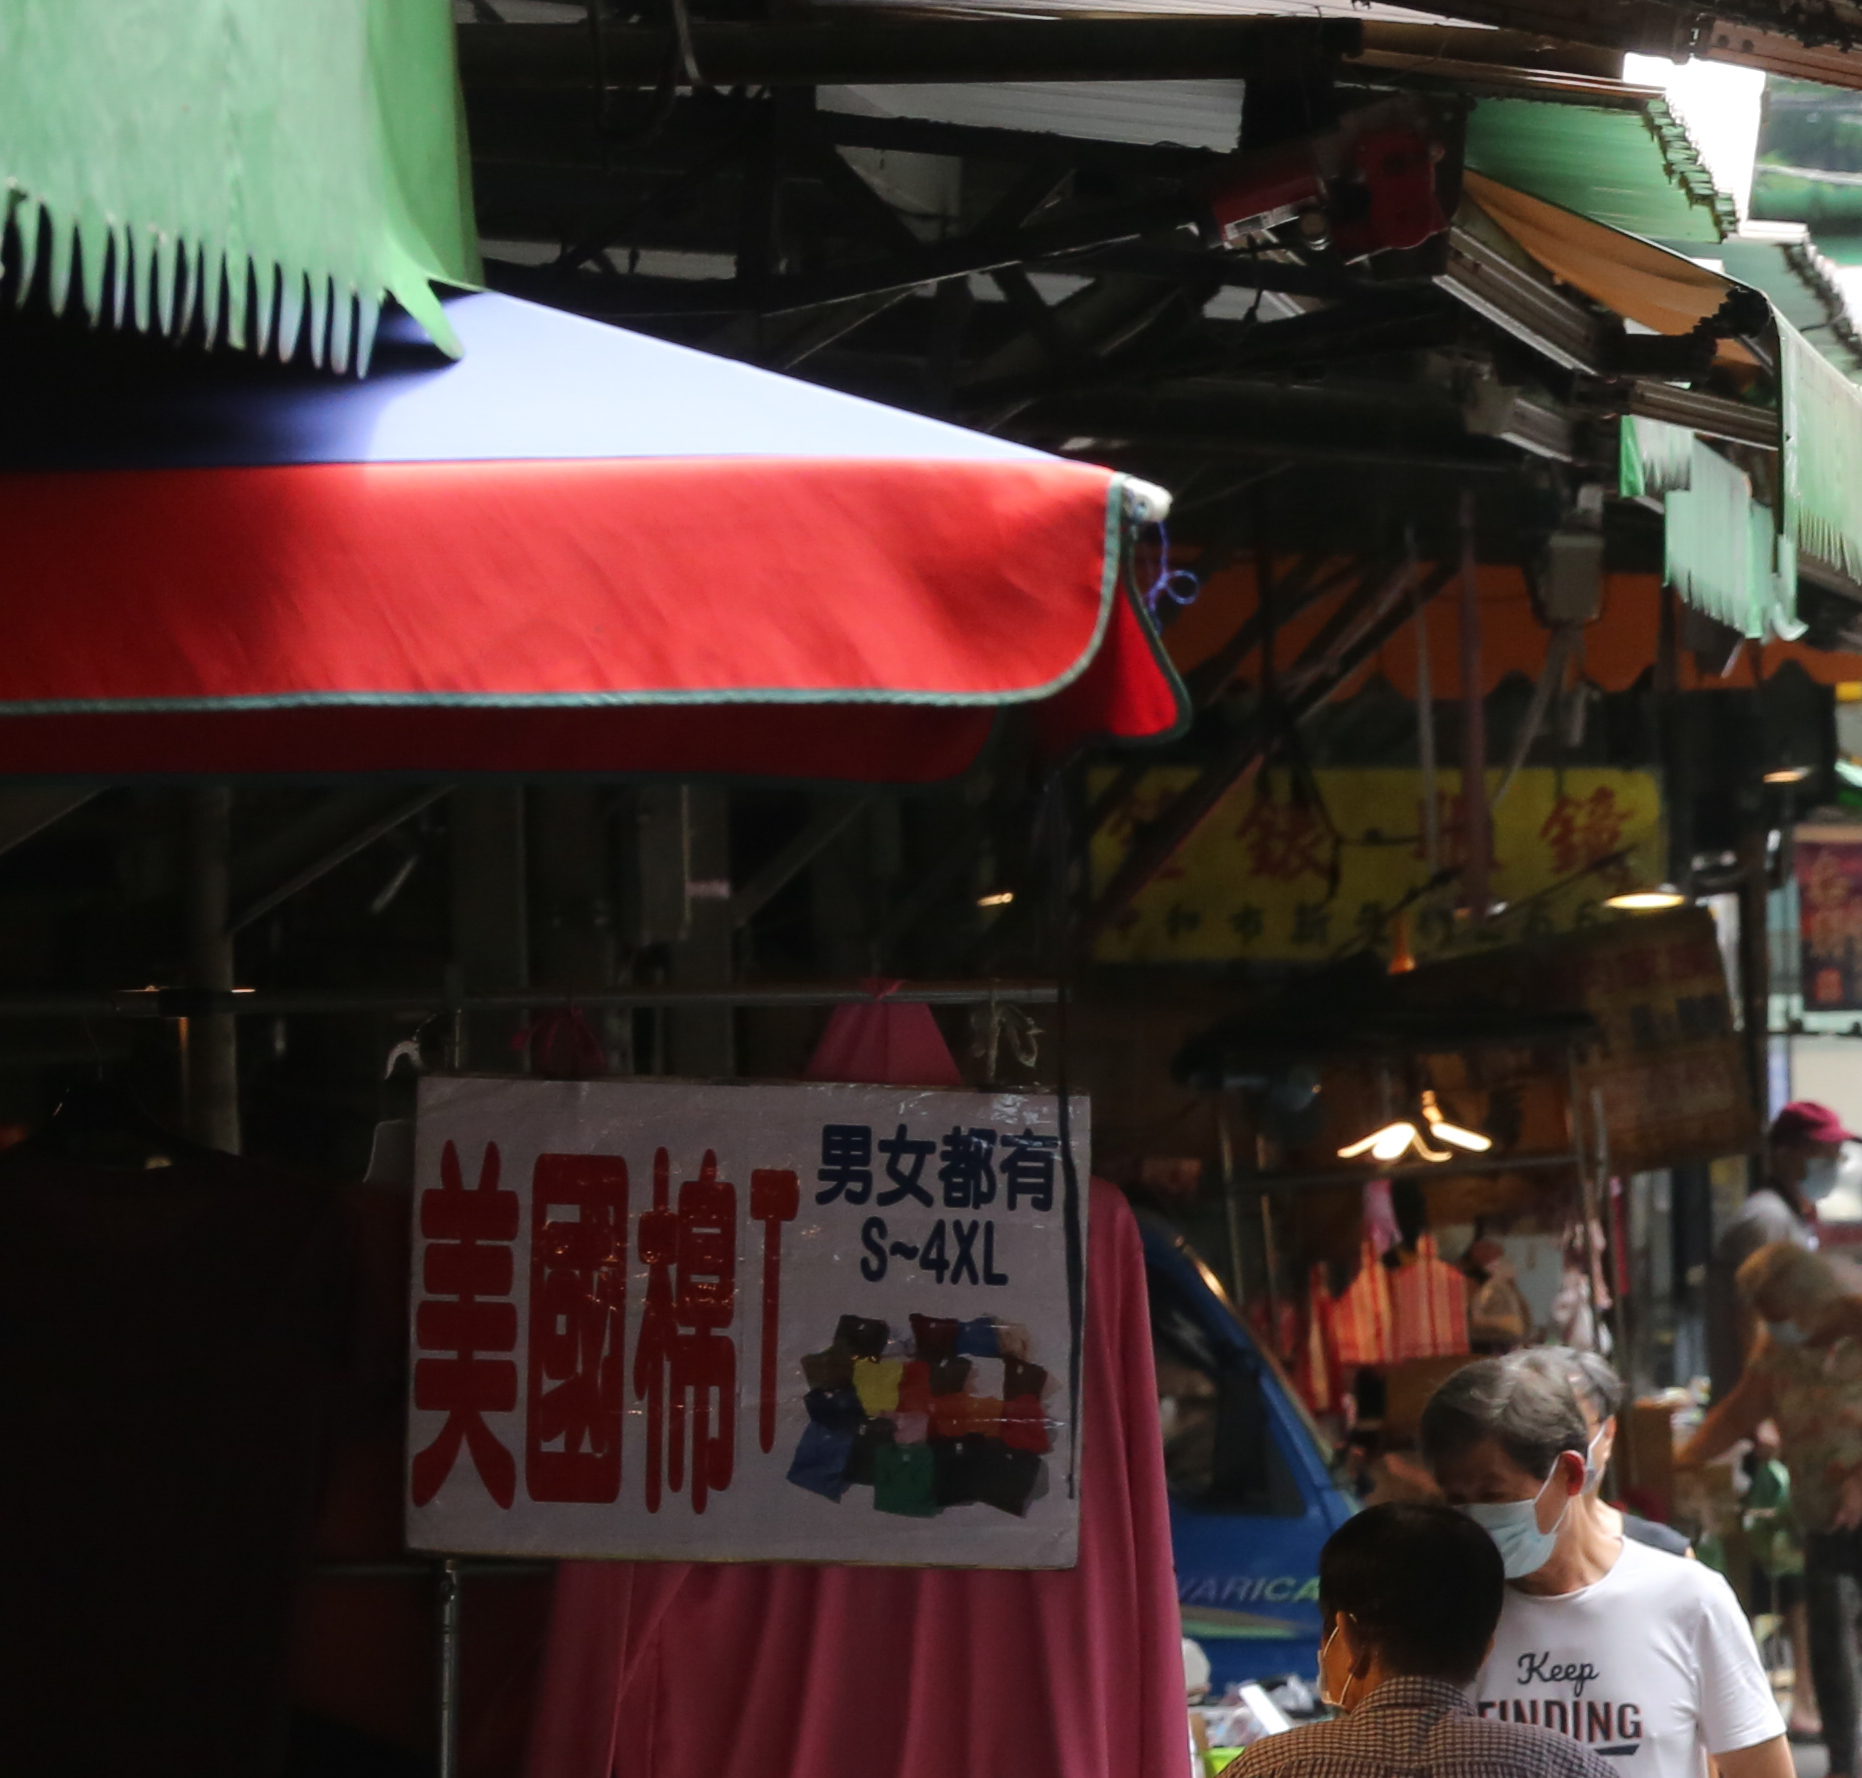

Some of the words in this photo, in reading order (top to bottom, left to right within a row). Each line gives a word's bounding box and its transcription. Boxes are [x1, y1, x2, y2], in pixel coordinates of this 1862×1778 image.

[815, 1124, 1059, 1214] 男女都有
[860, 1216, 1010, 1288] S~4XL
[1516, 1651, 1600, 1697] Keep
